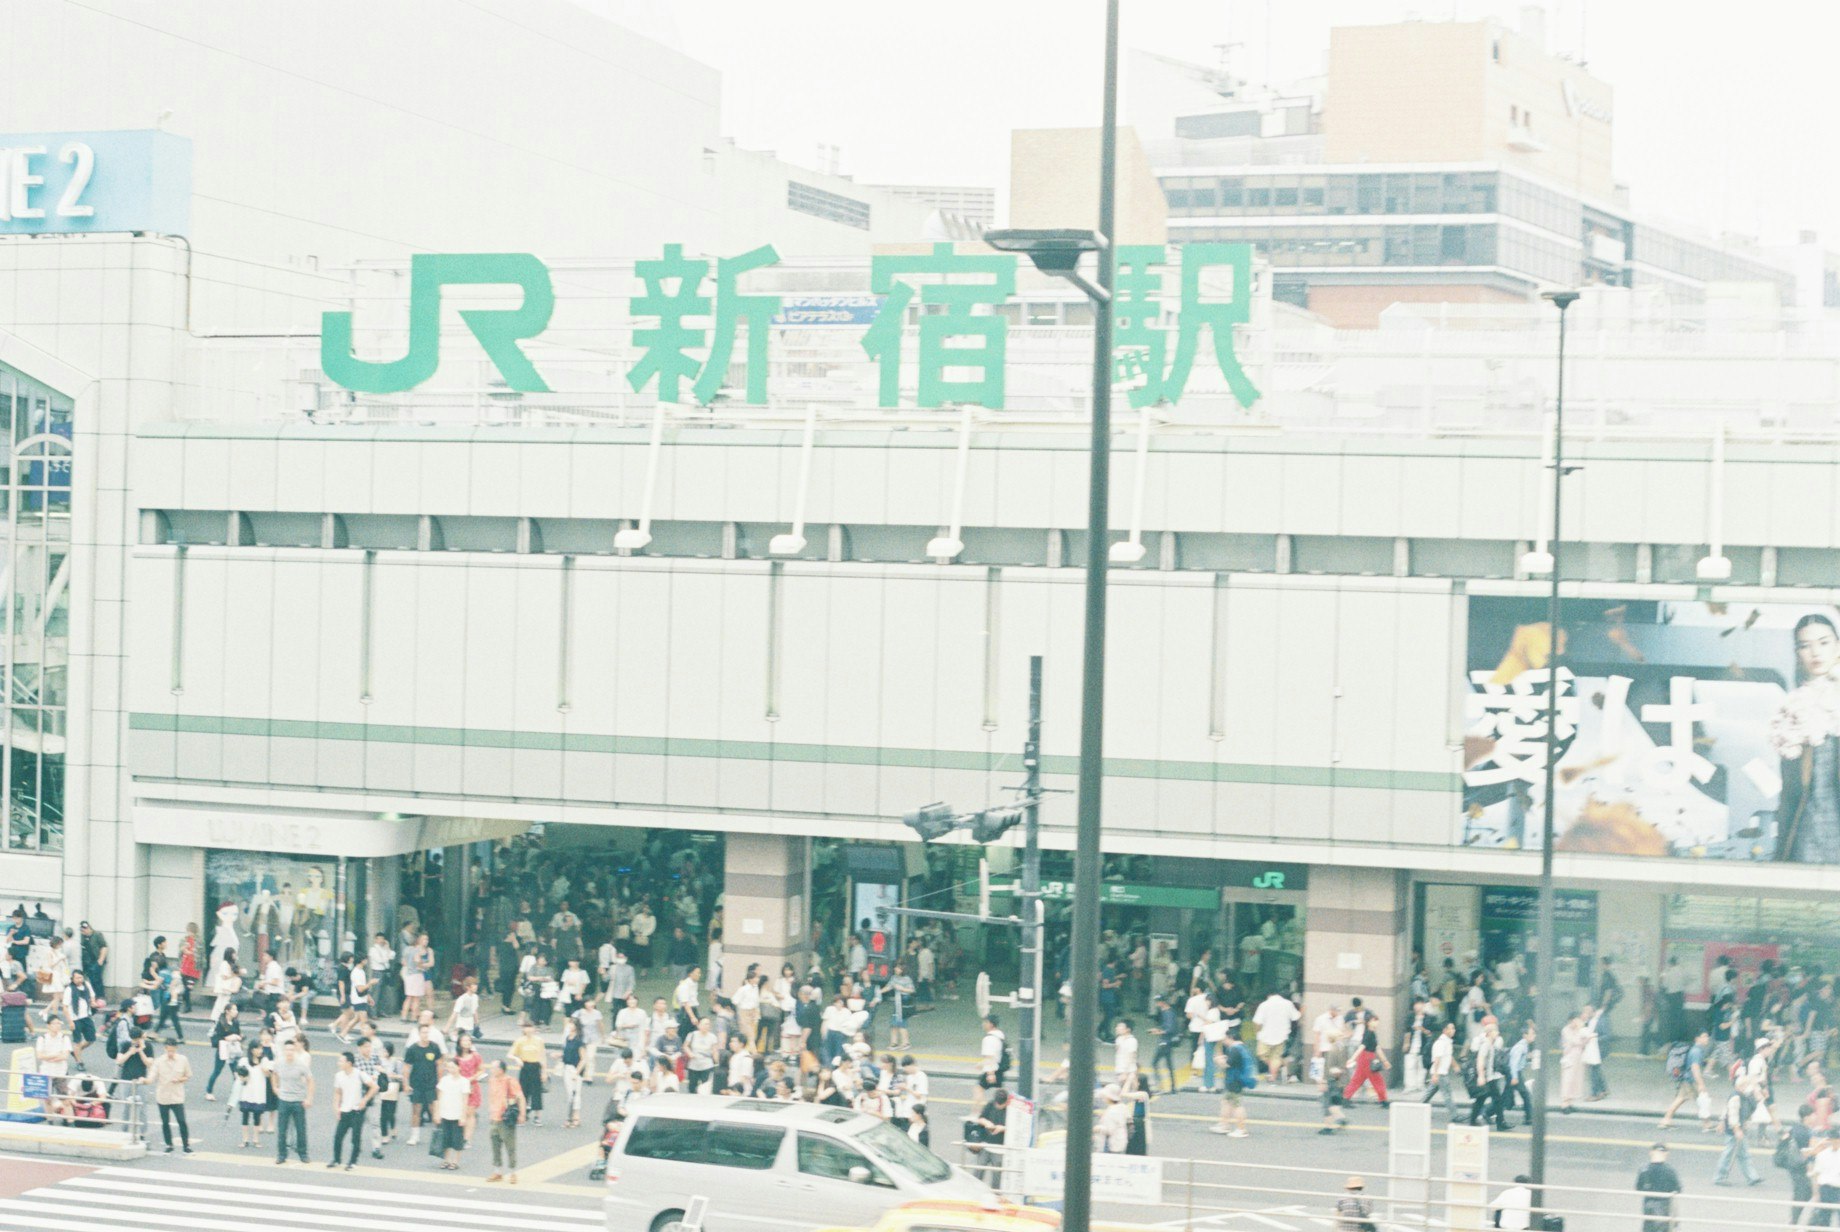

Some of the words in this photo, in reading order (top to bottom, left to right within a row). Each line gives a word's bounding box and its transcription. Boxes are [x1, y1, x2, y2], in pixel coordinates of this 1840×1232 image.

[0, 145, 47, 221] E
[56, 141, 95, 217] 2
[320, 251, 557, 394] JR
[625, 243, 1261, 410] 新宿駅
[306, 824, 323, 850] 2
[1252, 871, 1286, 889] JR
